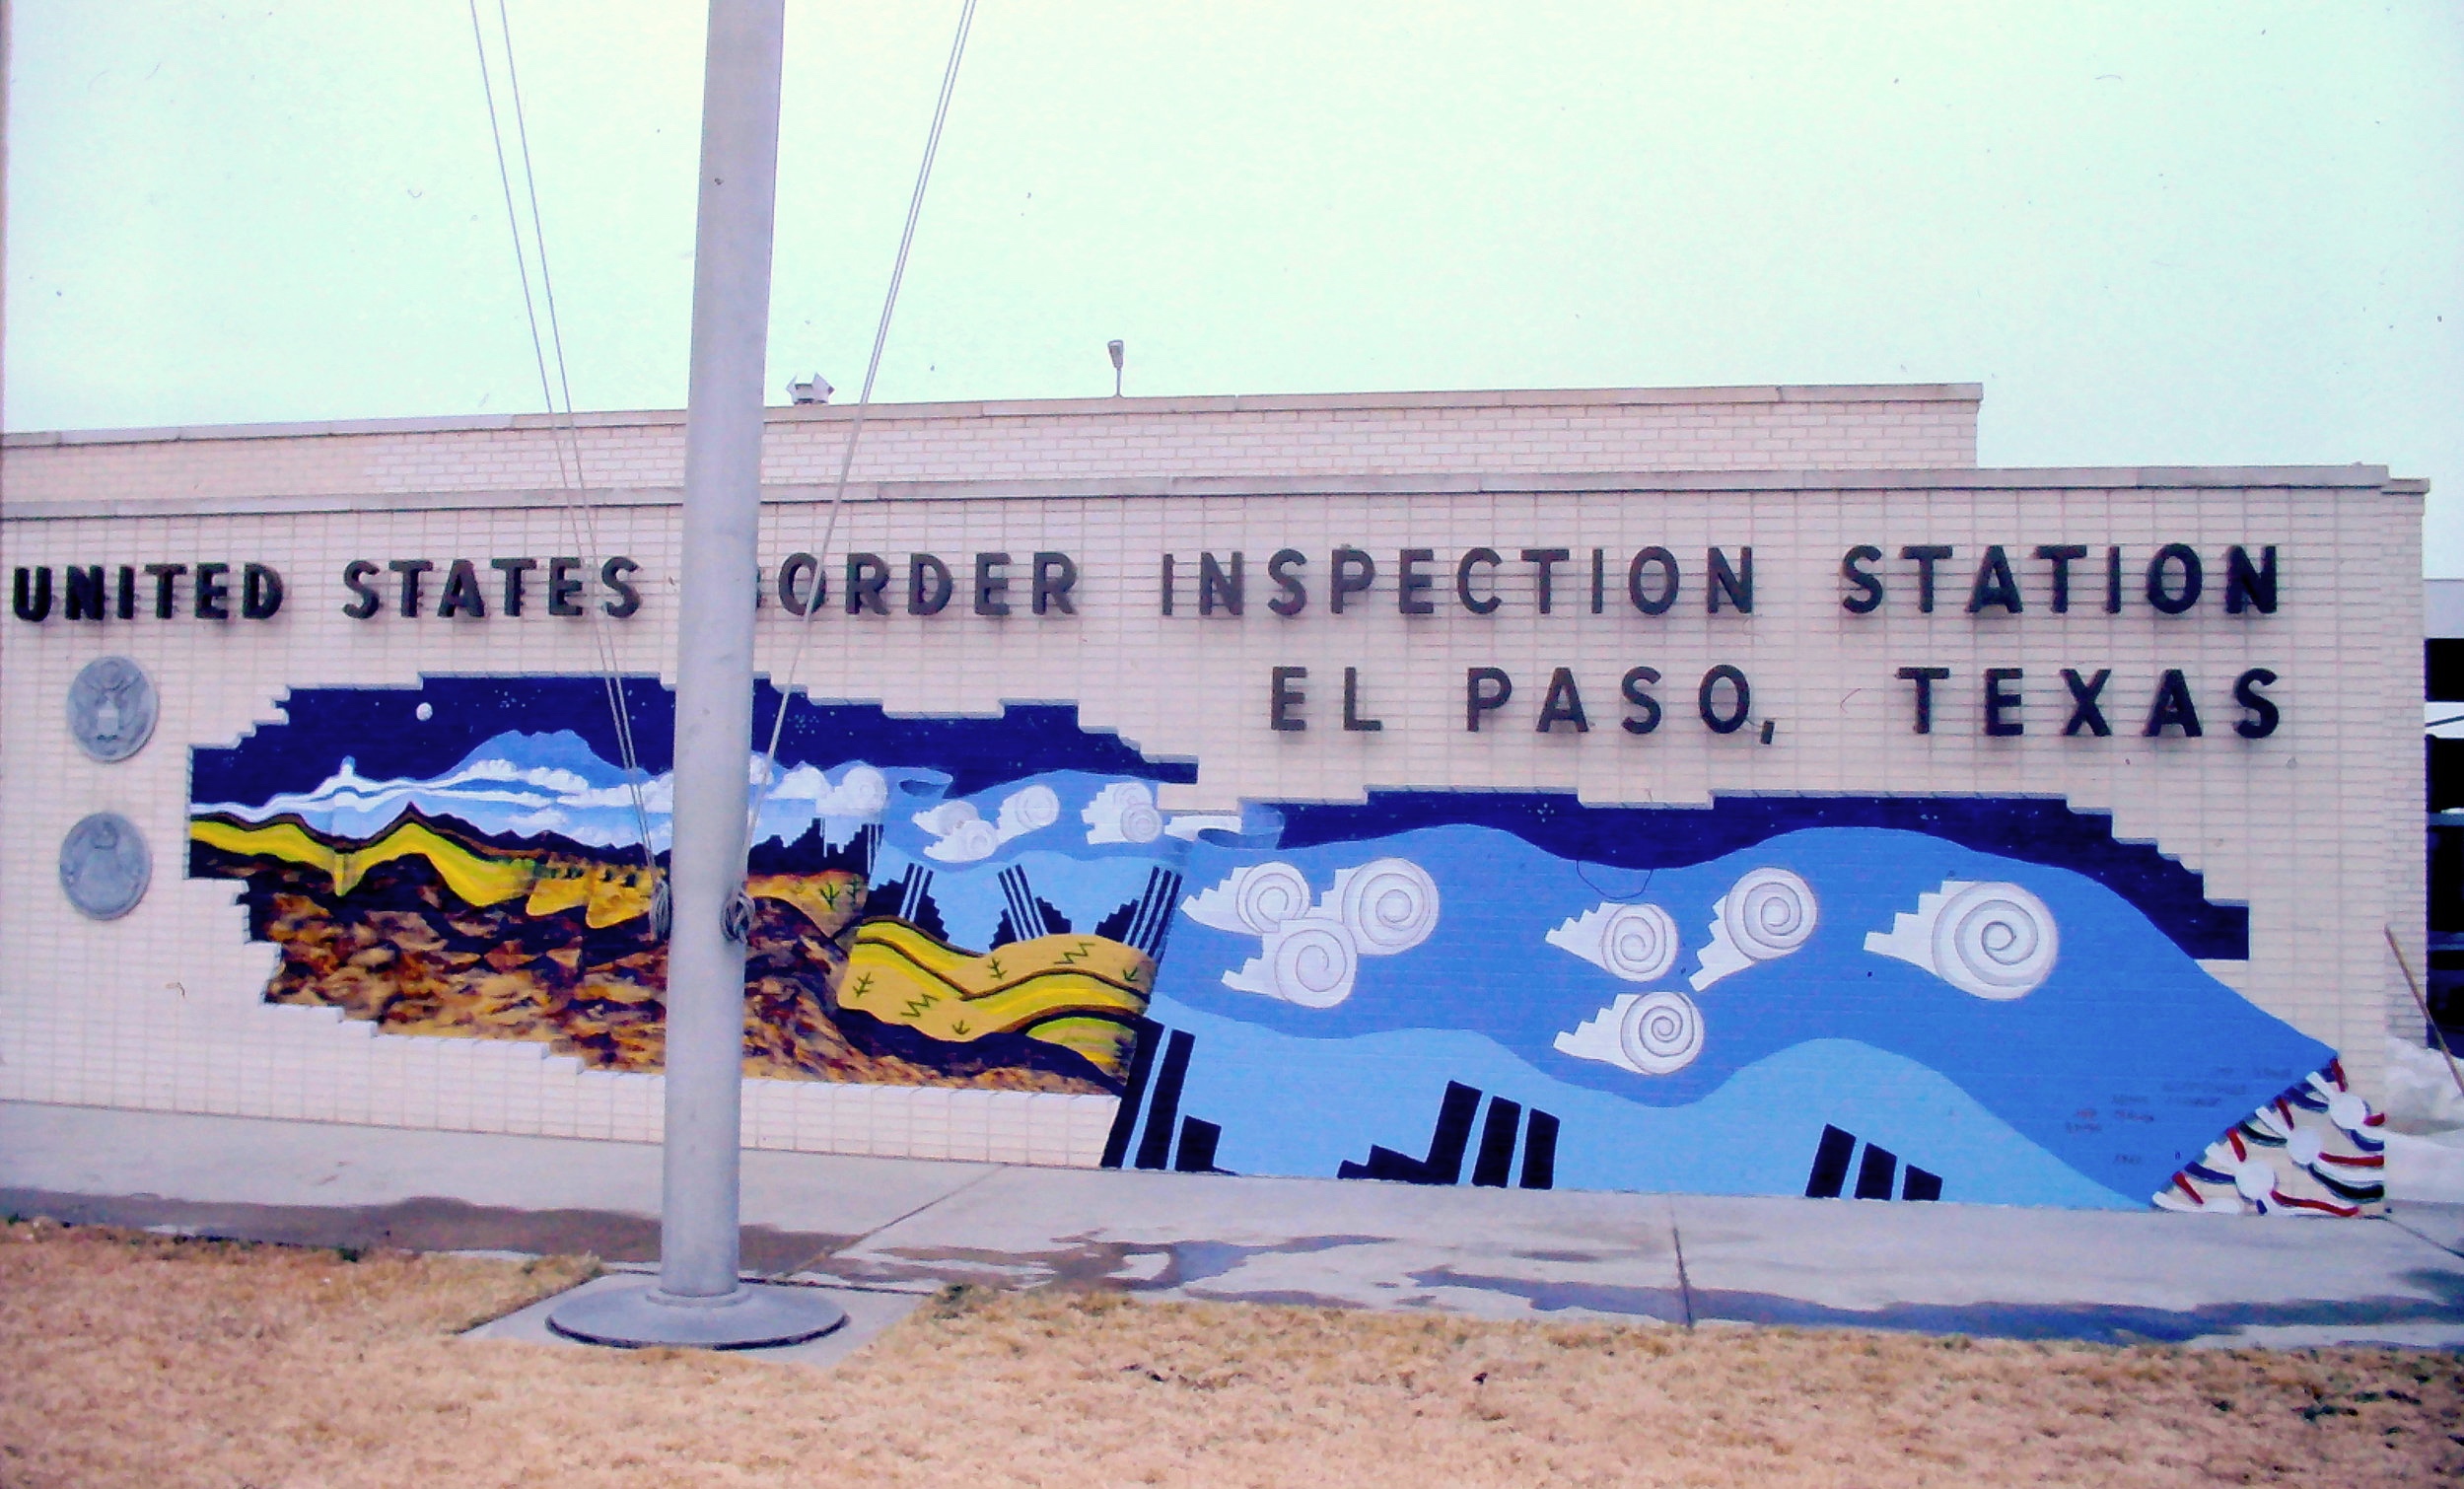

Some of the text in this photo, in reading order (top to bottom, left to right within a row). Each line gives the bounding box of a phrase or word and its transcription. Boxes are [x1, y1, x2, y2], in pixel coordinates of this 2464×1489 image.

[13, 542, 2280, 623] UNITED STATES ORDER INSPECTION STATION
[1271, 664, 2282, 744] EL PASO, TEXAS
